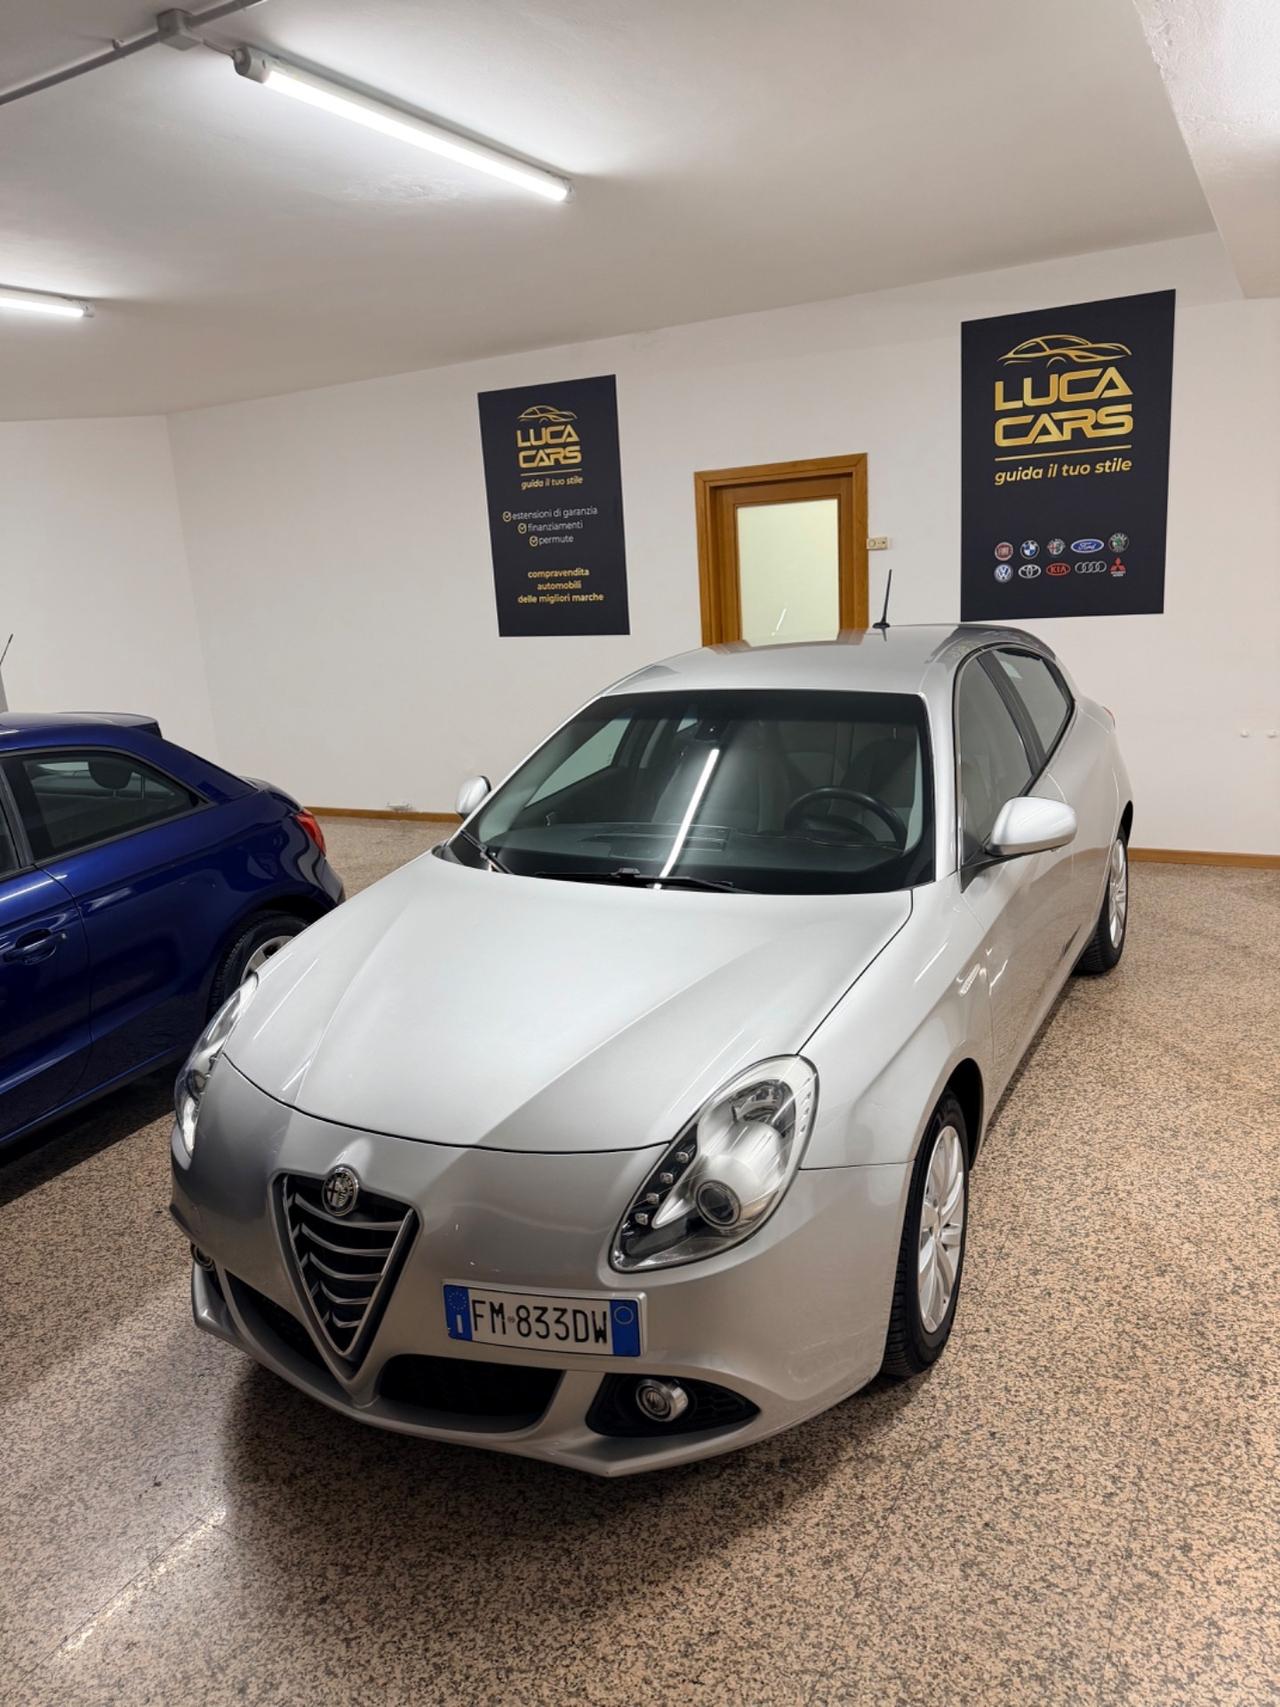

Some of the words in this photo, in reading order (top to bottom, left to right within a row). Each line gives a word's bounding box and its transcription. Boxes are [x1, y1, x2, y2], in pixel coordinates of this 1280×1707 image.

[994, 366, 1134, 411] LUCA
[994, 403, 1134, 447] CARS
[516, 425, 580, 448] LUCA
[518, 446, 582, 469] CARS
[995, 466, 1043, 486] guida
[1047, 464, 1058, 477] il
[1062, 464, 1090, 476] tuo
[1095, 457, 1132, 473] stile
[521, 478, 544, 490] guida
[545, 477, 551, 487] il
[551, 478, 565, 486] tuo
[566, 476, 583, 485] stile
[513, 508, 552, 520] estensioni
[554, 508, 562, 517] di
[563, 506, 598, 519] garanzia
[528, 521, 583, 533] finanziamenti
[539, 534, 574, 546] permute
[527, 567, 590, 580] compravendita
[1050, 565, 1066, 574] KIA
[537, 581, 581, 591] automobili
[518, 595, 537, 604] delle
[539, 594, 570, 605] migliori
[572, 593, 604, 602] marche
